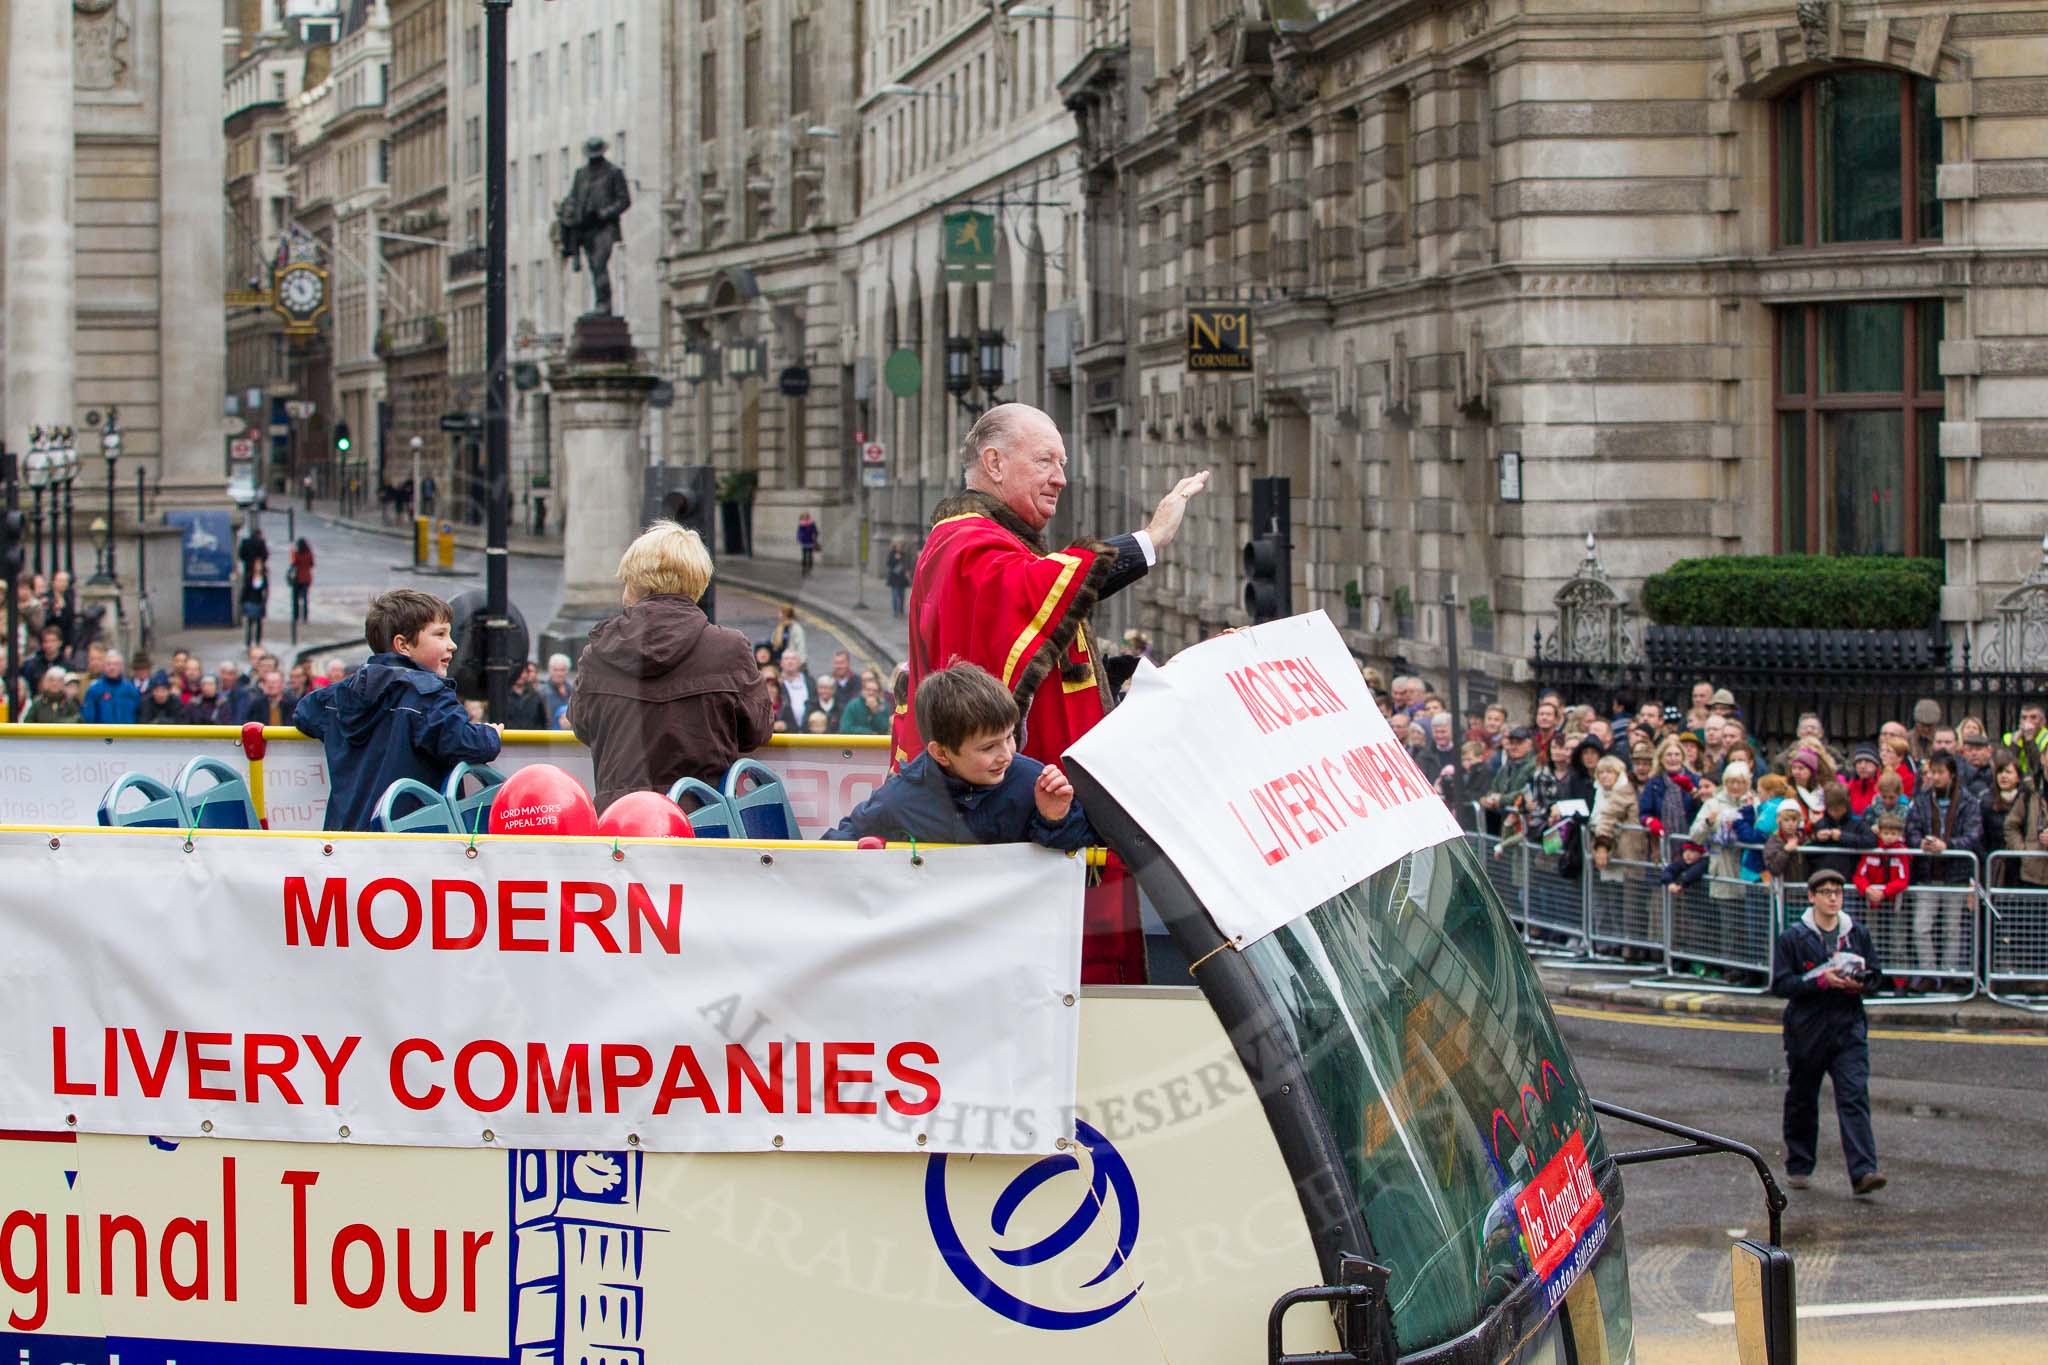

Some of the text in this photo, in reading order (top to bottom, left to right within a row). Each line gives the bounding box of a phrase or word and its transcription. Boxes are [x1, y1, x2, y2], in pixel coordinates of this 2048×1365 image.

[1191, 353, 1248, 367] CORNHILL
[500, 808, 520, 820] LORD
[504, 815, 558, 830] APPEAL 2013
[1228, 764, 1348, 867] LIVERY
[283, 876, 684, 954] MODERN
[52, 1026, 942, 1115] LIVERY COMPANIES
[280, 1170, 495, 1313] Tour
[1521, 1155, 1596, 1259] The Original Tour
[1547, 1217, 1608, 1306] London Sightseeing
